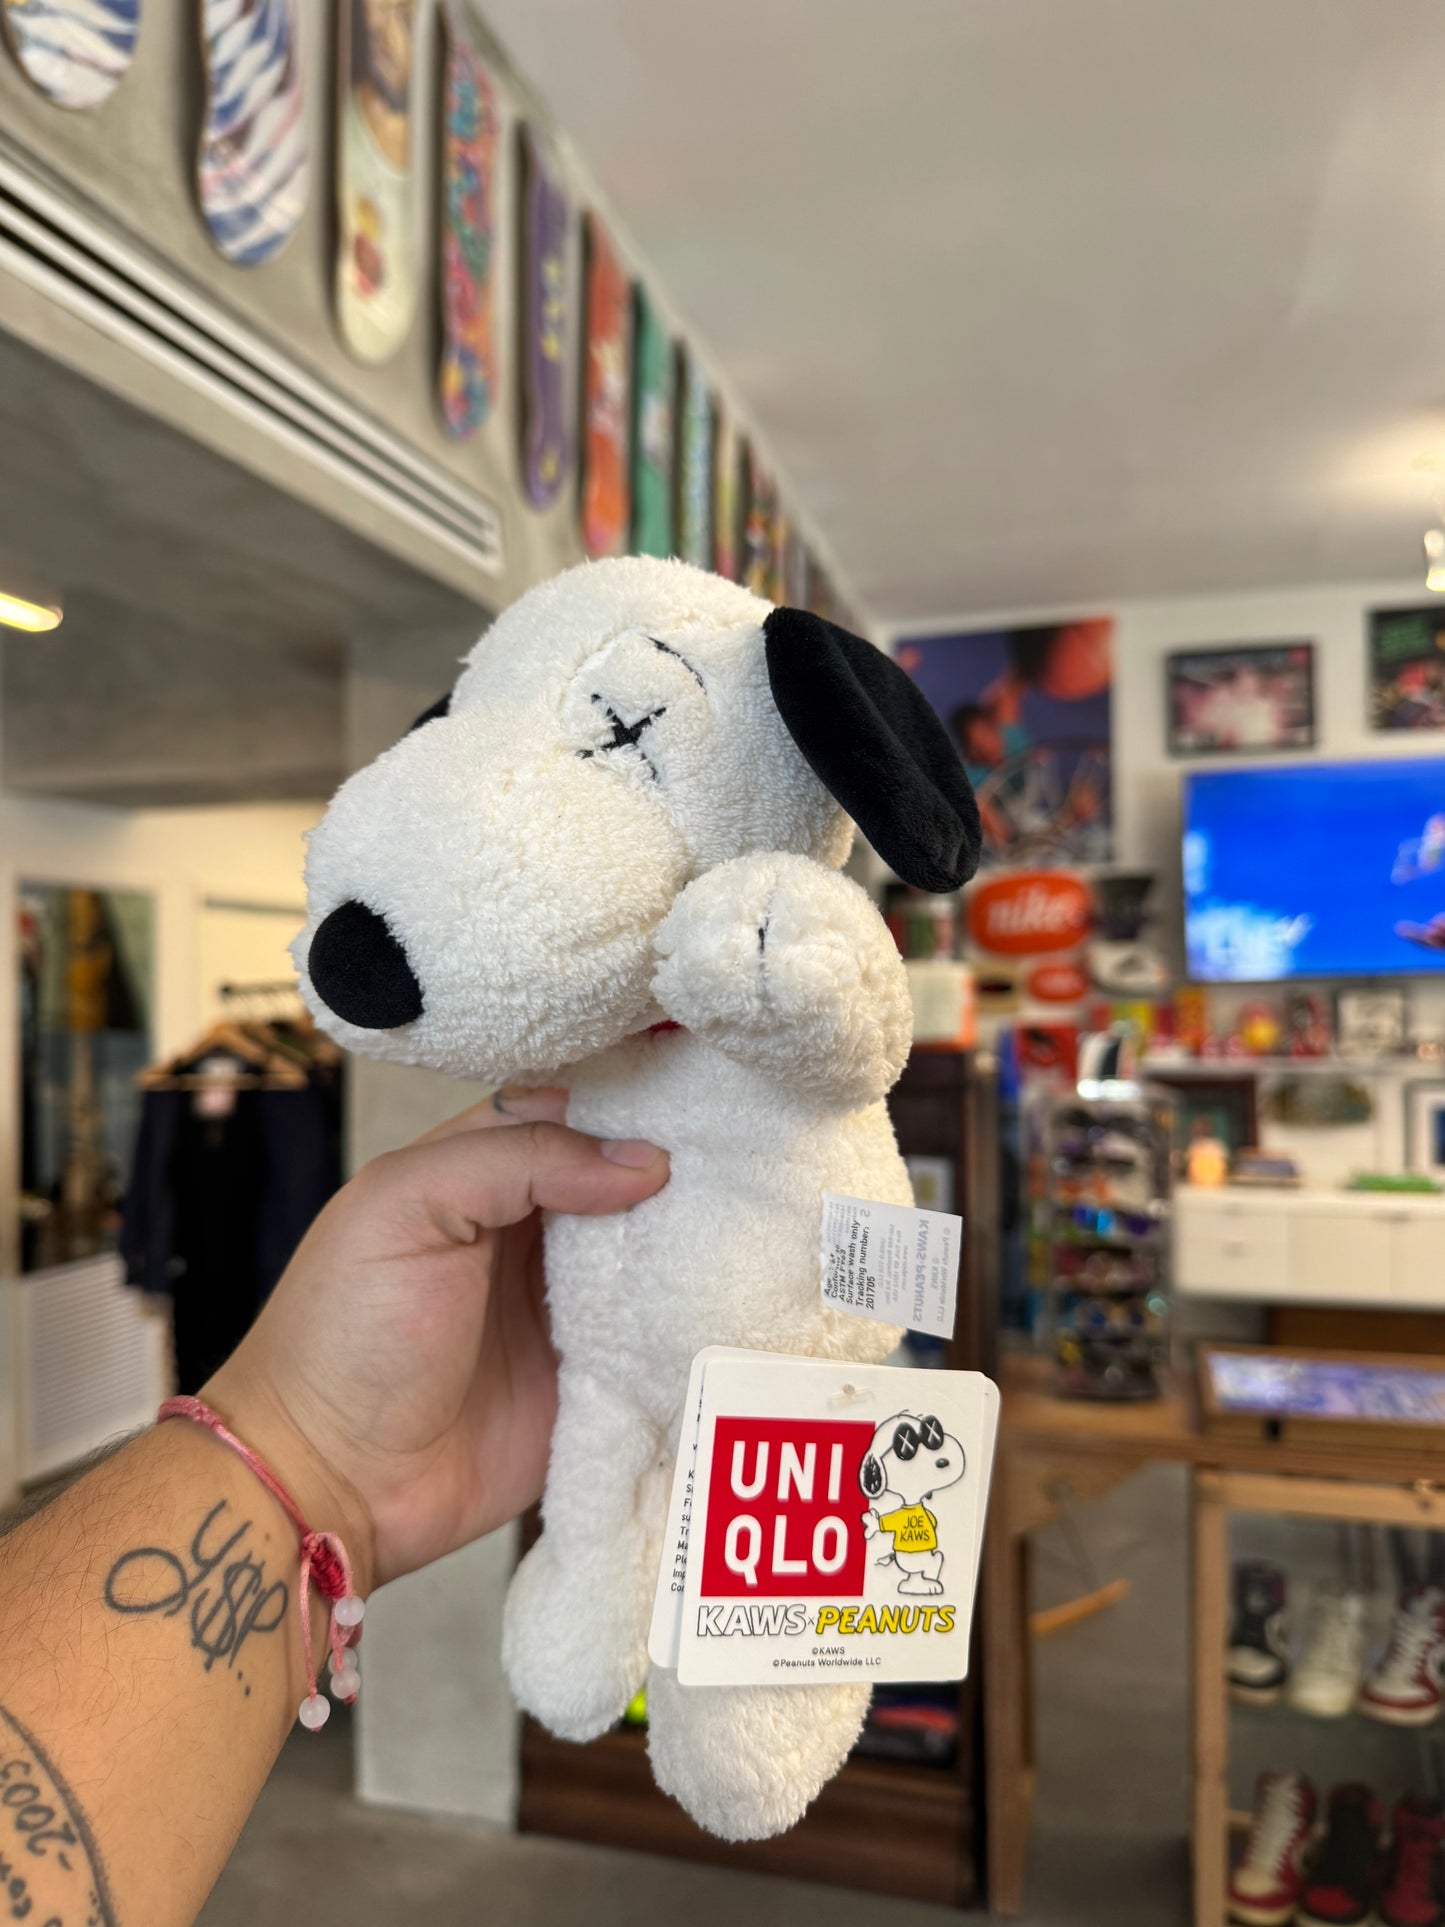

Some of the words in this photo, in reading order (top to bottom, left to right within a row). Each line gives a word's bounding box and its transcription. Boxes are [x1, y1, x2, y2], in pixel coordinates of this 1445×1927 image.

[986, 882, 1078, 936] nike
[851, 1219, 860, 1240] only
[860, 1226, 870, 1263] number:
[848, 1242, 857, 1266] wash
[824, 1277, 833, 1296] Age
[846, 1269, 855, 1304] Surface
[855, 1266, 867, 1307] Tracking
[866, 1275, 876, 1310] 201705
[730, 1440, 843, 1503] UNI
[900, 1529, 930, 1542] KAWS
[903, 1515, 925, 1529] JOE
[724, 1513, 849, 1587] QLO
[817, 1657, 863, 1667] Worldwide
[865, 1656, 882, 1666] LLC
